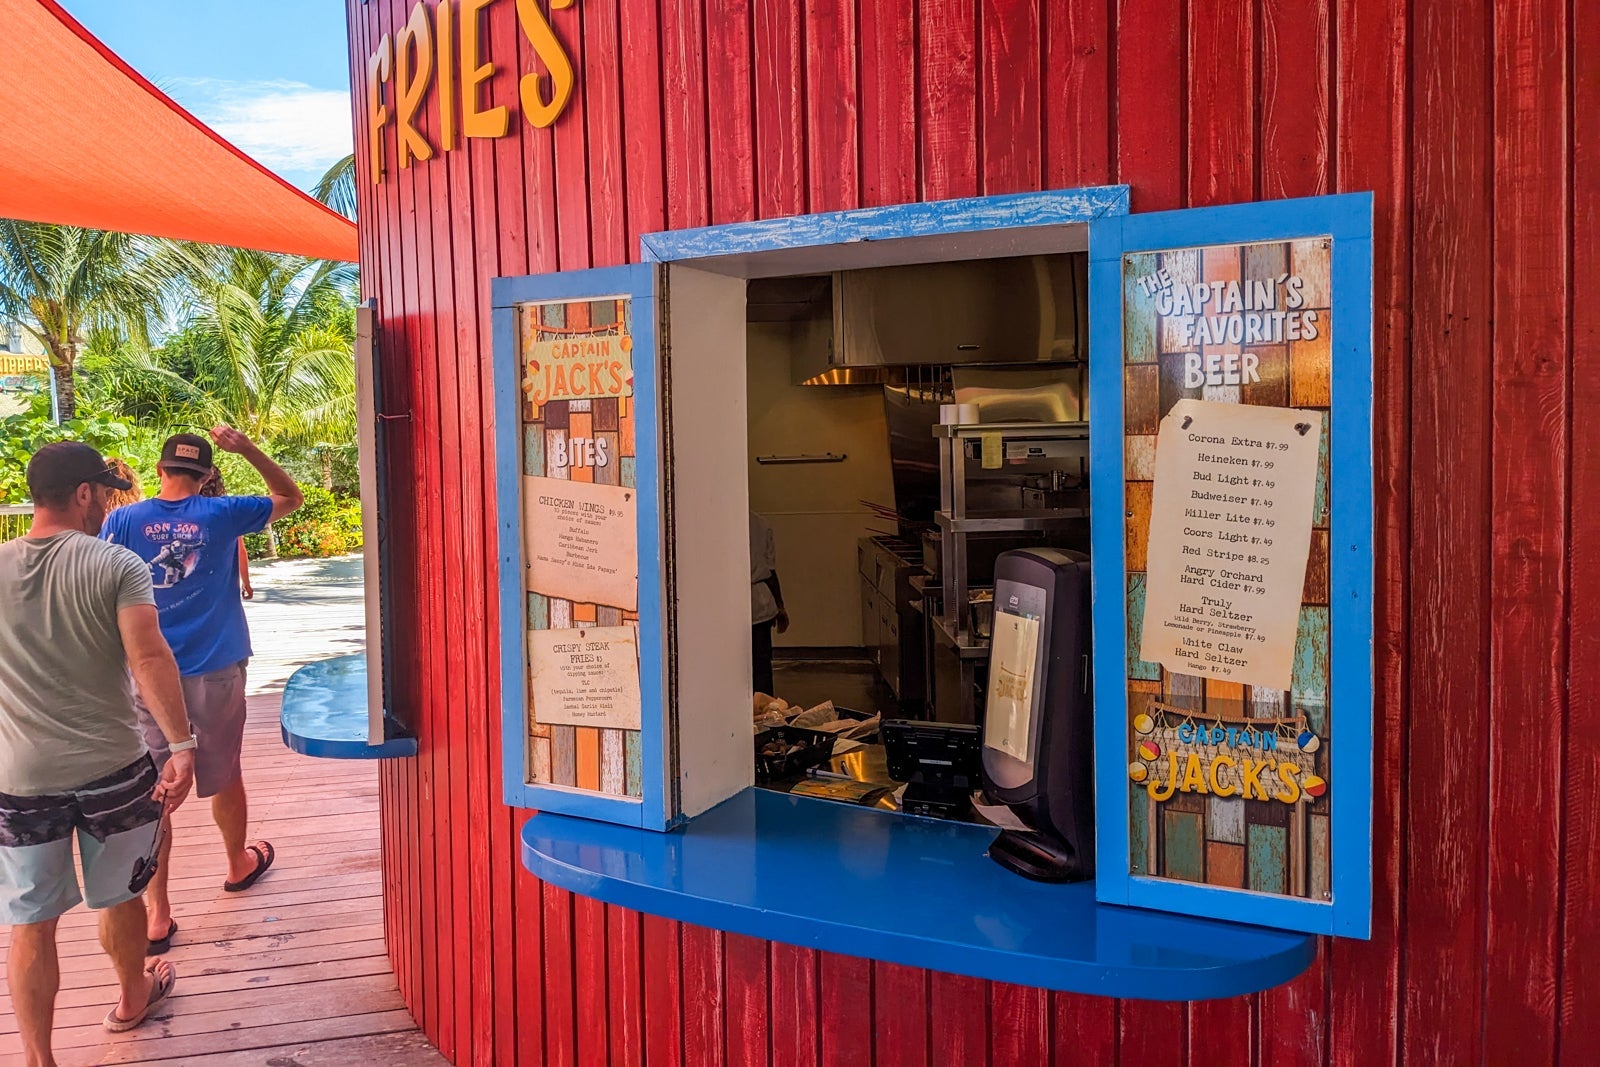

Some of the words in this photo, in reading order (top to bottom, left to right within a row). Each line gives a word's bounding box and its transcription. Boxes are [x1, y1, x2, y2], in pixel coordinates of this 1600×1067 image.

[369, 0, 574, 184] FRIES
[1137, 268, 1173, 299] THE
[1155, 272, 1304, 317] CAPTAIN'S
[1181, 310, 1318, 347] FAVORITES
[551, 340, 610, 360] CAPTAIN
[1184, 352, 1261, 389] BEER
[533, 360, 622, 406] JACK'S
[1188, 433, 1225, 445] Corona
[1231, 436, 1263, 448] Extra
[1265, 441, 1289, 451] $7.99
[556, 437, 608, 468] BITES
[1197, 452, 1248, 466] Heineken
[1251, 459, 1274, 469] $7.99
[1192, 471, 1212, 481] Bud
[1217, 473, 1249, 486] Light
[1252, 479, 1275, 489] $7.49
[539, 495, 574, 510] CHICKEN
[579, 501, 605, 514] WINGS
[1190, 490, 1248, 504] Budweiser
[1250, 498, 1273, 508] $7.49
[1184, 508, 1221, 520] Miller
[1226, 513, 1251, 524] Lite
[1253, 517, 1275, 527] $7.49
[1183, 527, 1213, 538] Coors
[1218, 531, 1249, 543] Light
[1251, 536, 1273, 546] $7.49
[1182, 545, 1201, 556] Red
[1206, 548, 1244, 562] Stripe
[1184, 564, 1215, 577] Angry
[1220, 569, 1263, 583] Orchard
[1180, 574, 1204, 586] Hard
[1210, 578, 1241, 591] Cider
[1243, 584, 1266, 595] $7.99
[1201, 595, 1233, 610] Truly
[1179, 603, 1204, 615] Hard
[1209, 608, 1253, 622] Seltzer
[1164, 620, 1194, 631] Lemonade
[1207, 627, 1241, 638] Pineapple
[1245, 633, 1266, 643] $7.49
[1174, 615, 1189, 623] Wild
[1192, 617, 1214, 627] Berry,
[1217, 621, 1256, 634] Strawberry
[553, 643, 582, 653] CRISPY
[585, 641, 610, 652] STEAK
[1182, 637, 1213, 649] White
[1217, 643, 1244, 654] Claw
[570, 654, 594, 664] FRIES
[1174, 648, 1199, 659] Hard
[1204, 652, 1248, 667] Seltzer
[1187, 661, 1207, 671] Mango
[1211, 665, 1232, 675] $7.49
[1178, 723, 1278, 751] CAPTAIN
[1147, 751, 1302, 804] JACK'S
